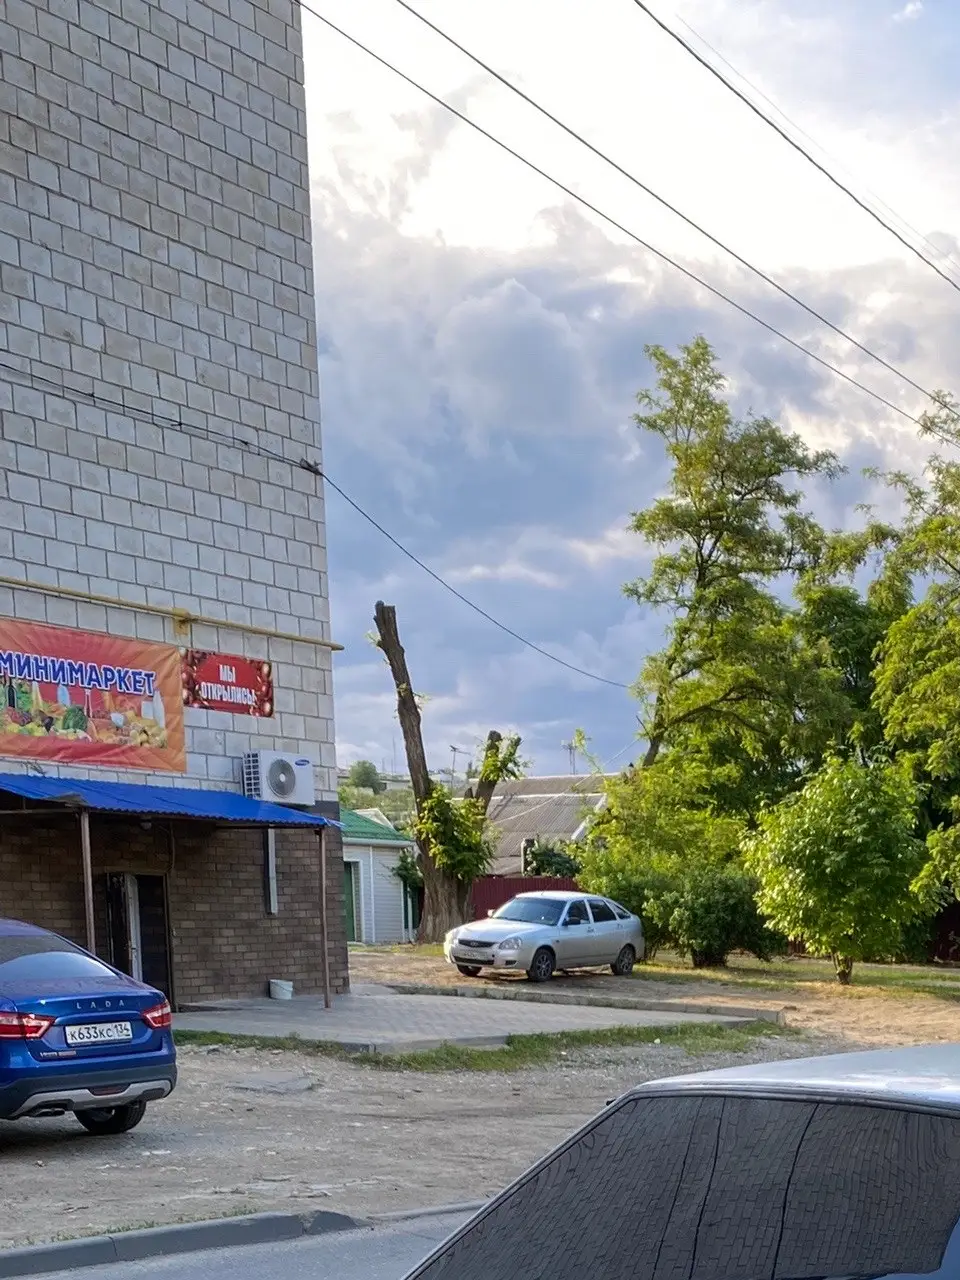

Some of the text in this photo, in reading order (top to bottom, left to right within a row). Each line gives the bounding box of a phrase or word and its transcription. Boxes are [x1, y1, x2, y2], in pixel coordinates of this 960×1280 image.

[0, 650, 156, 697] МИНИМАРКЕТ
[219, 664, 236, 683] МЫ
[76, 999, 125, 1009] LADA
